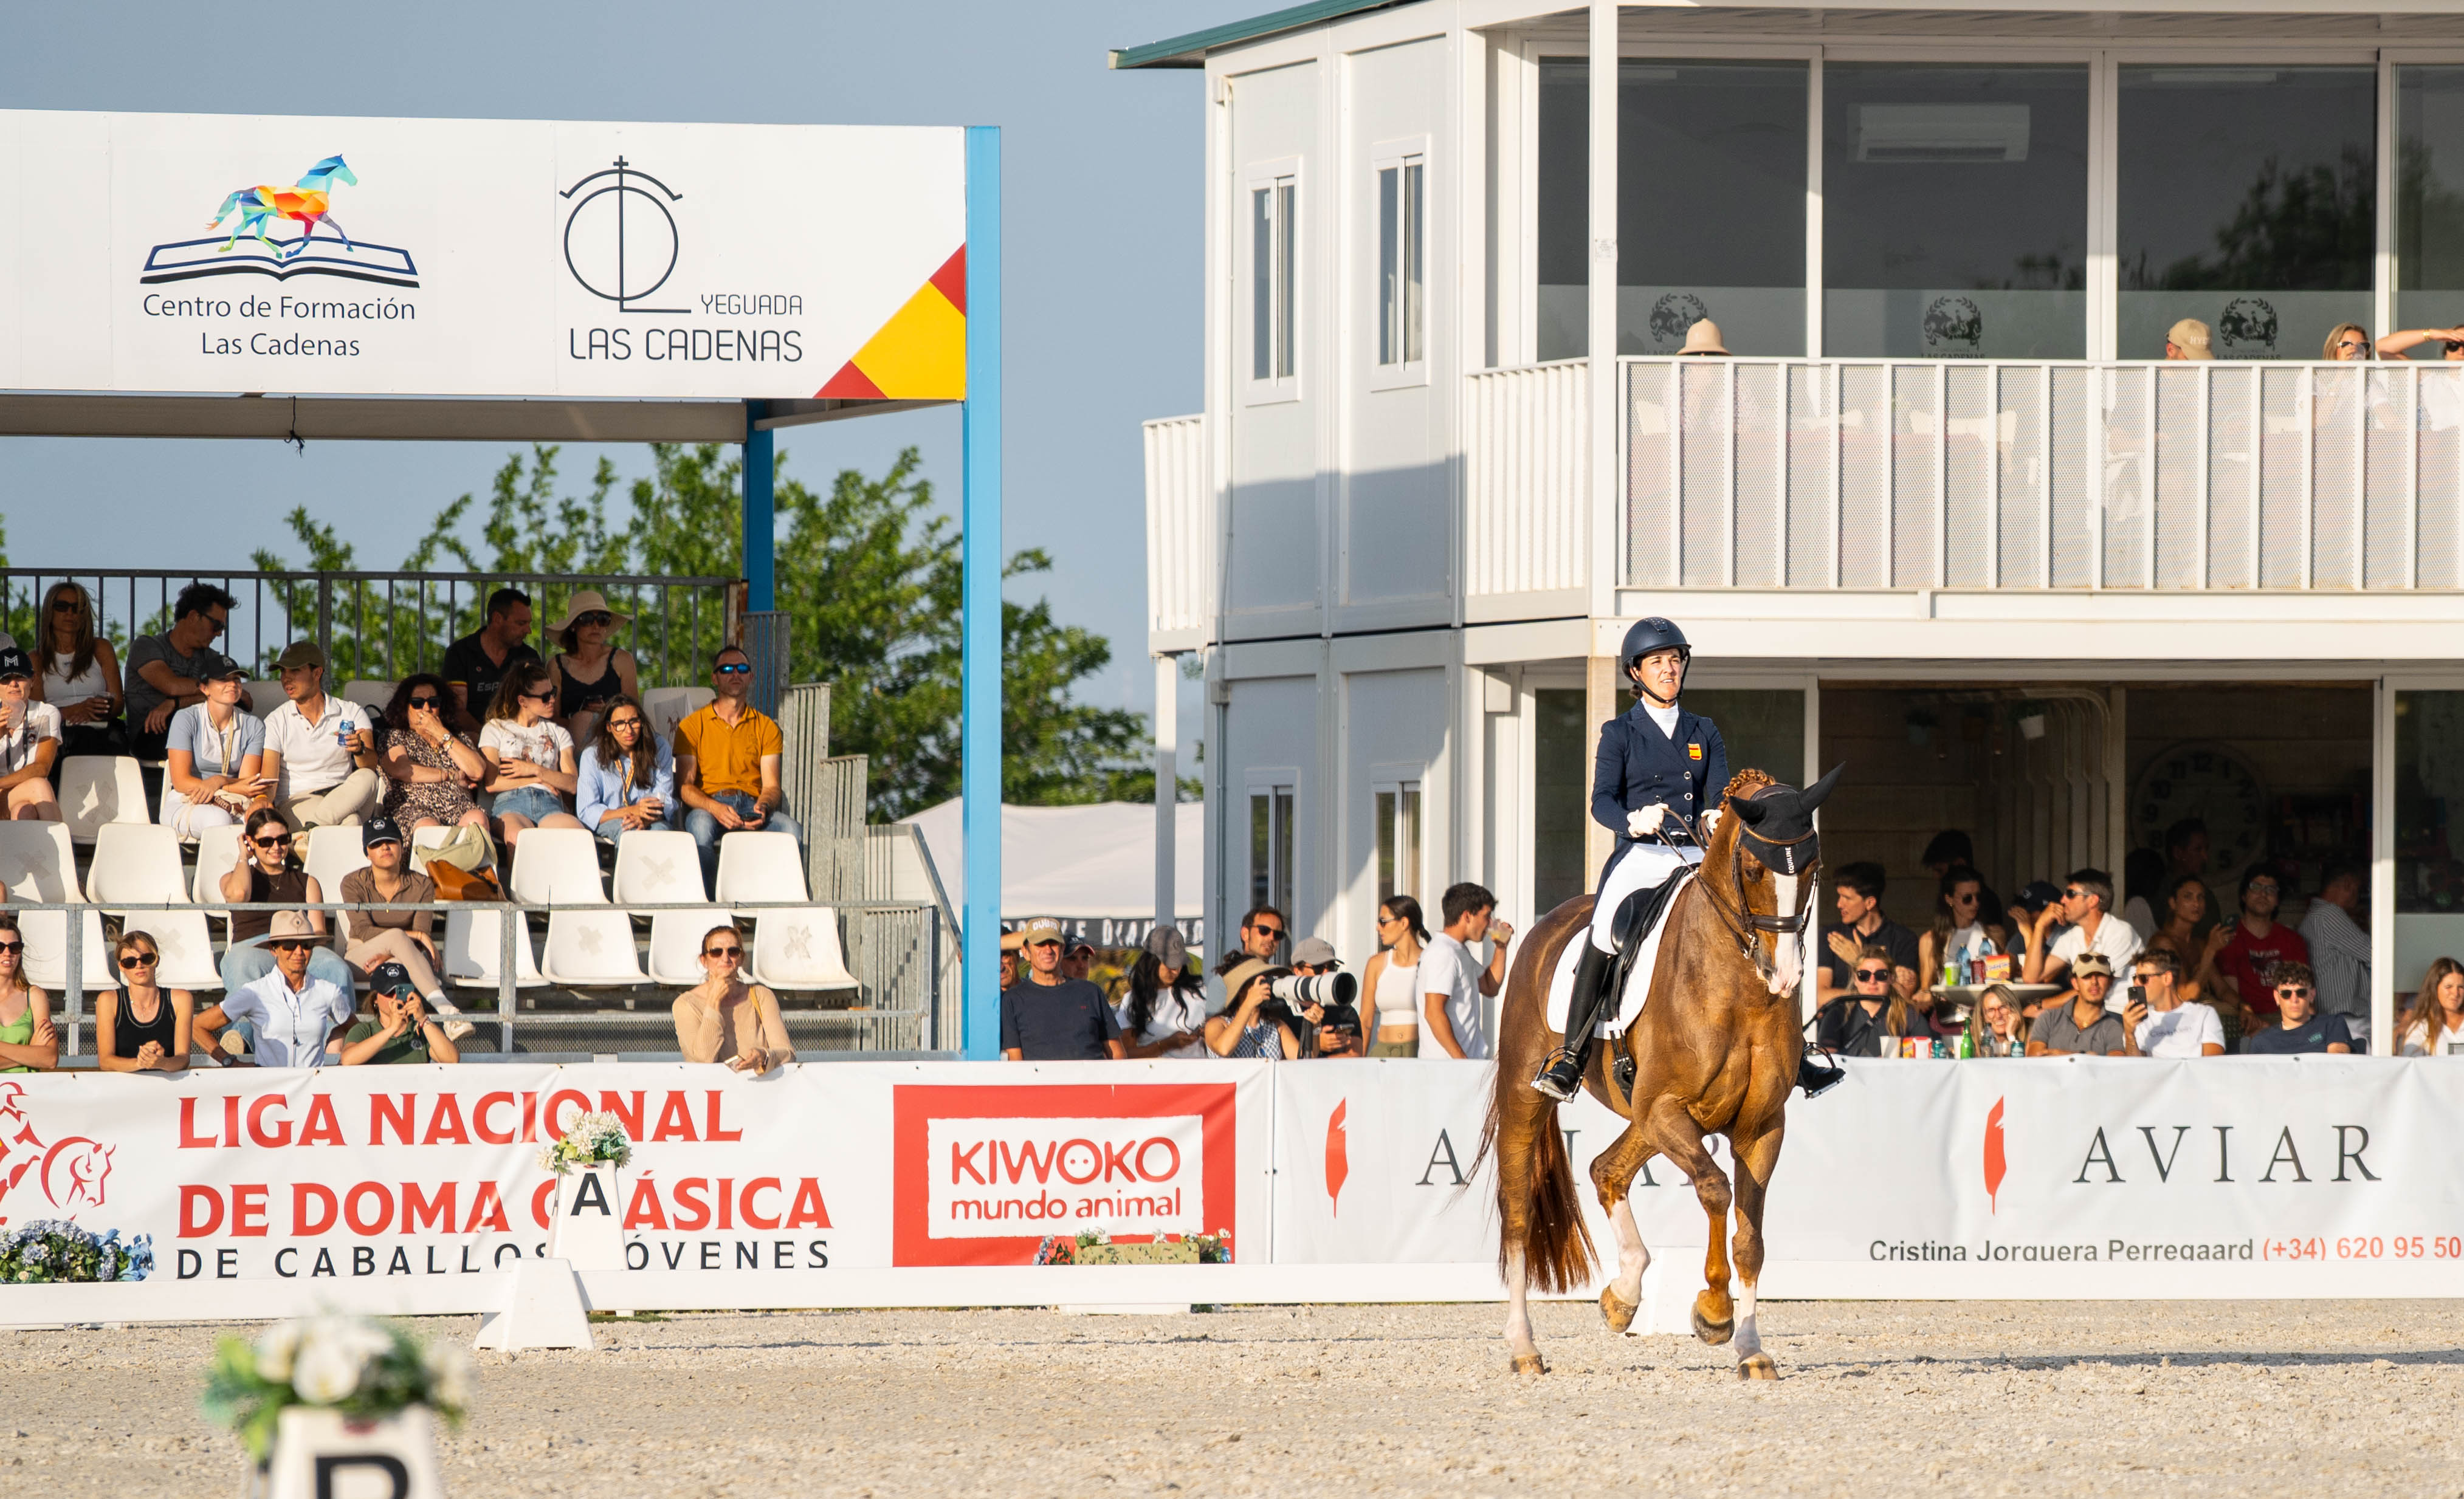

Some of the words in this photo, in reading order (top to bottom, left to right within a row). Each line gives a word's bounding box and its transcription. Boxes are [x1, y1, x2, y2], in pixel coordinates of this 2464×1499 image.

[143, 293, 231, 317] Centro
[239, 294, 272, 318] de
[281, 297, 415, 320] Formación
[701, 293, 802, 315] YEGUADA
[202, 332, 242, 355] Las
[250, 332, 360, 356] Cadenas
[570, 328, 631, 360] LAS
[645, 328, 802, 362] CADENAS
[1784, 846, 1795, 874] EQUILINE
[179, 1093, 346, 1148] LIGA
[370, 1089, 743, 1146] NACIONAL
[952, 1136, 1180, 1185] KIWOKO
[2072, 1125, 2382, 1184] AVIAR
[177, 1184, 269, 1238] DE
[291, 1181, 512, 1237] DOMA
[531, 1170, 833, 1232] CÁSICA
[570, 1172, 611, 1216] A
[951, 1189, 1067, 1221] mundo
[1075, 1187, 1180, 1218] animal
[177, 1249, 238, 1280] DE
[626, 1234, 829, 1271] ÓVENES
[1870, 1240, 1966, 1261] Cristina
[2262, 1237, 2327, 1260] (+34)
[2336, 1235, 2384, 1260] 620
[2393, 1235, 2426, 1259] 95
[2432, 1235, 2463, 1260] 50
